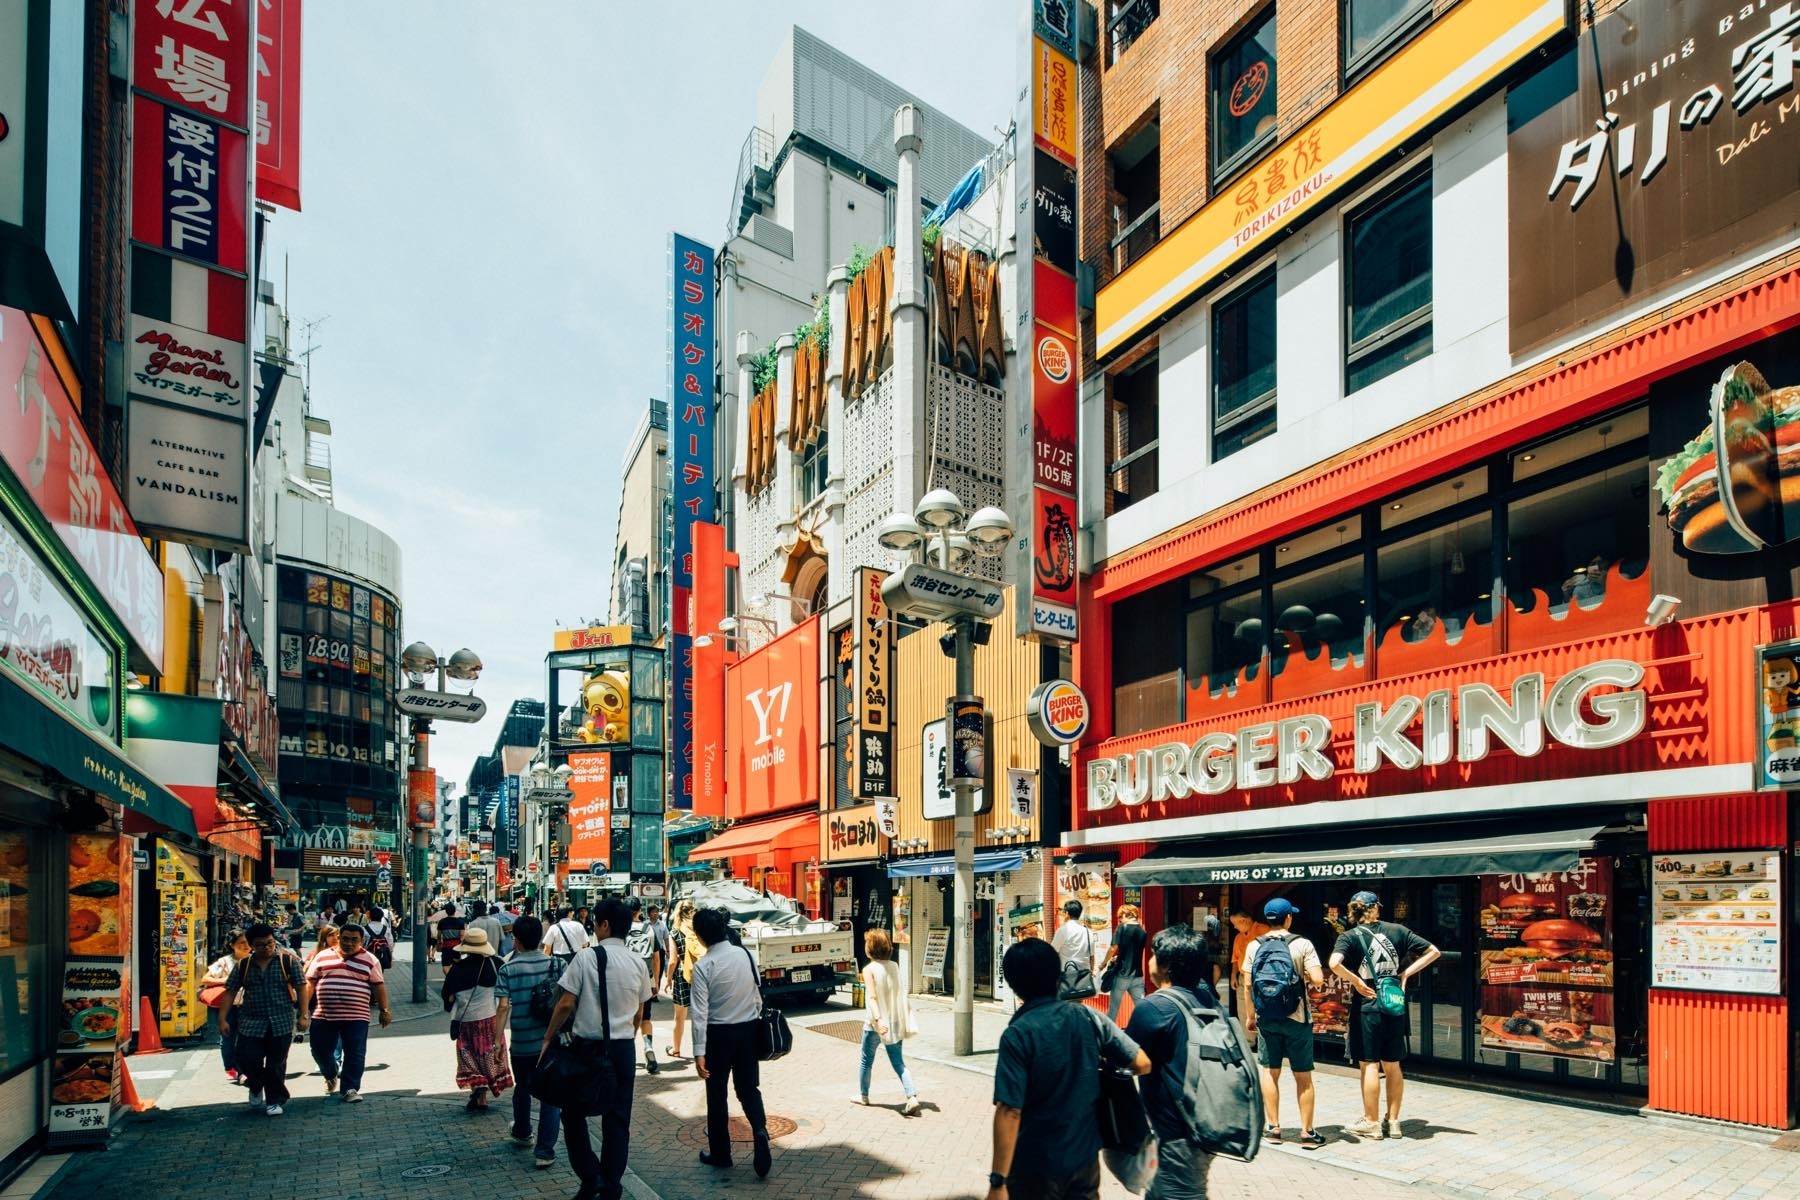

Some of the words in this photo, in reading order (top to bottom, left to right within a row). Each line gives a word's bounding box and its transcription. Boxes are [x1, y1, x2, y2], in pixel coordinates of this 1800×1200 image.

[1605, 38, 1695, 106] Dining
[1716, 119, 1772, 166] Dali
[168, 112, 216, 250] 受付2F
[1233, 172, 1323, 248] TORIKIZOKU
[136, 330, 225, 366] Miami
[1043, 349, 1066, 359] BURGER
[1044, 357, 1067, 369] KING
[135, 372, 241, 406] マイアミガーデン
[151, 438, 226, 460] ALTERNATIVE
[157, 459, 184, 471] CAFE
[198, 468, 220, 478] BAR
[1038, 462, 1072, 487] 105席
[136, 476, 239, 505] VANDALISM
[910, 574, 999, 608] 渋谷センター街
[1034, 608, 1075, 632] センタービル
[402, 694, 482, 713] 渋谷センター街
[1049, 695, 1082, 712] BURGER
[1050, 705, 1084, 726] KING
[1354, 659, 1648, 775] KING
[751, 748, 786, 773] mobile
[1087, 713, 1335, 812] BURGER
[865, 781, 885, 794] B1F
[1017, 777, 1031, 815] 寿司
[882, 803, 895, 834] 寿司
[1211, 870, 1248, 880] HOME
[1252, 867, 1270, 879] OF
[1309, 862, 1387, 877] WHOPPER
[1535, 883, 1555, 893] AKA
[1523, 992, 1546, 1001] TWIN
[1547, 993, 1562, 1001] PIE
